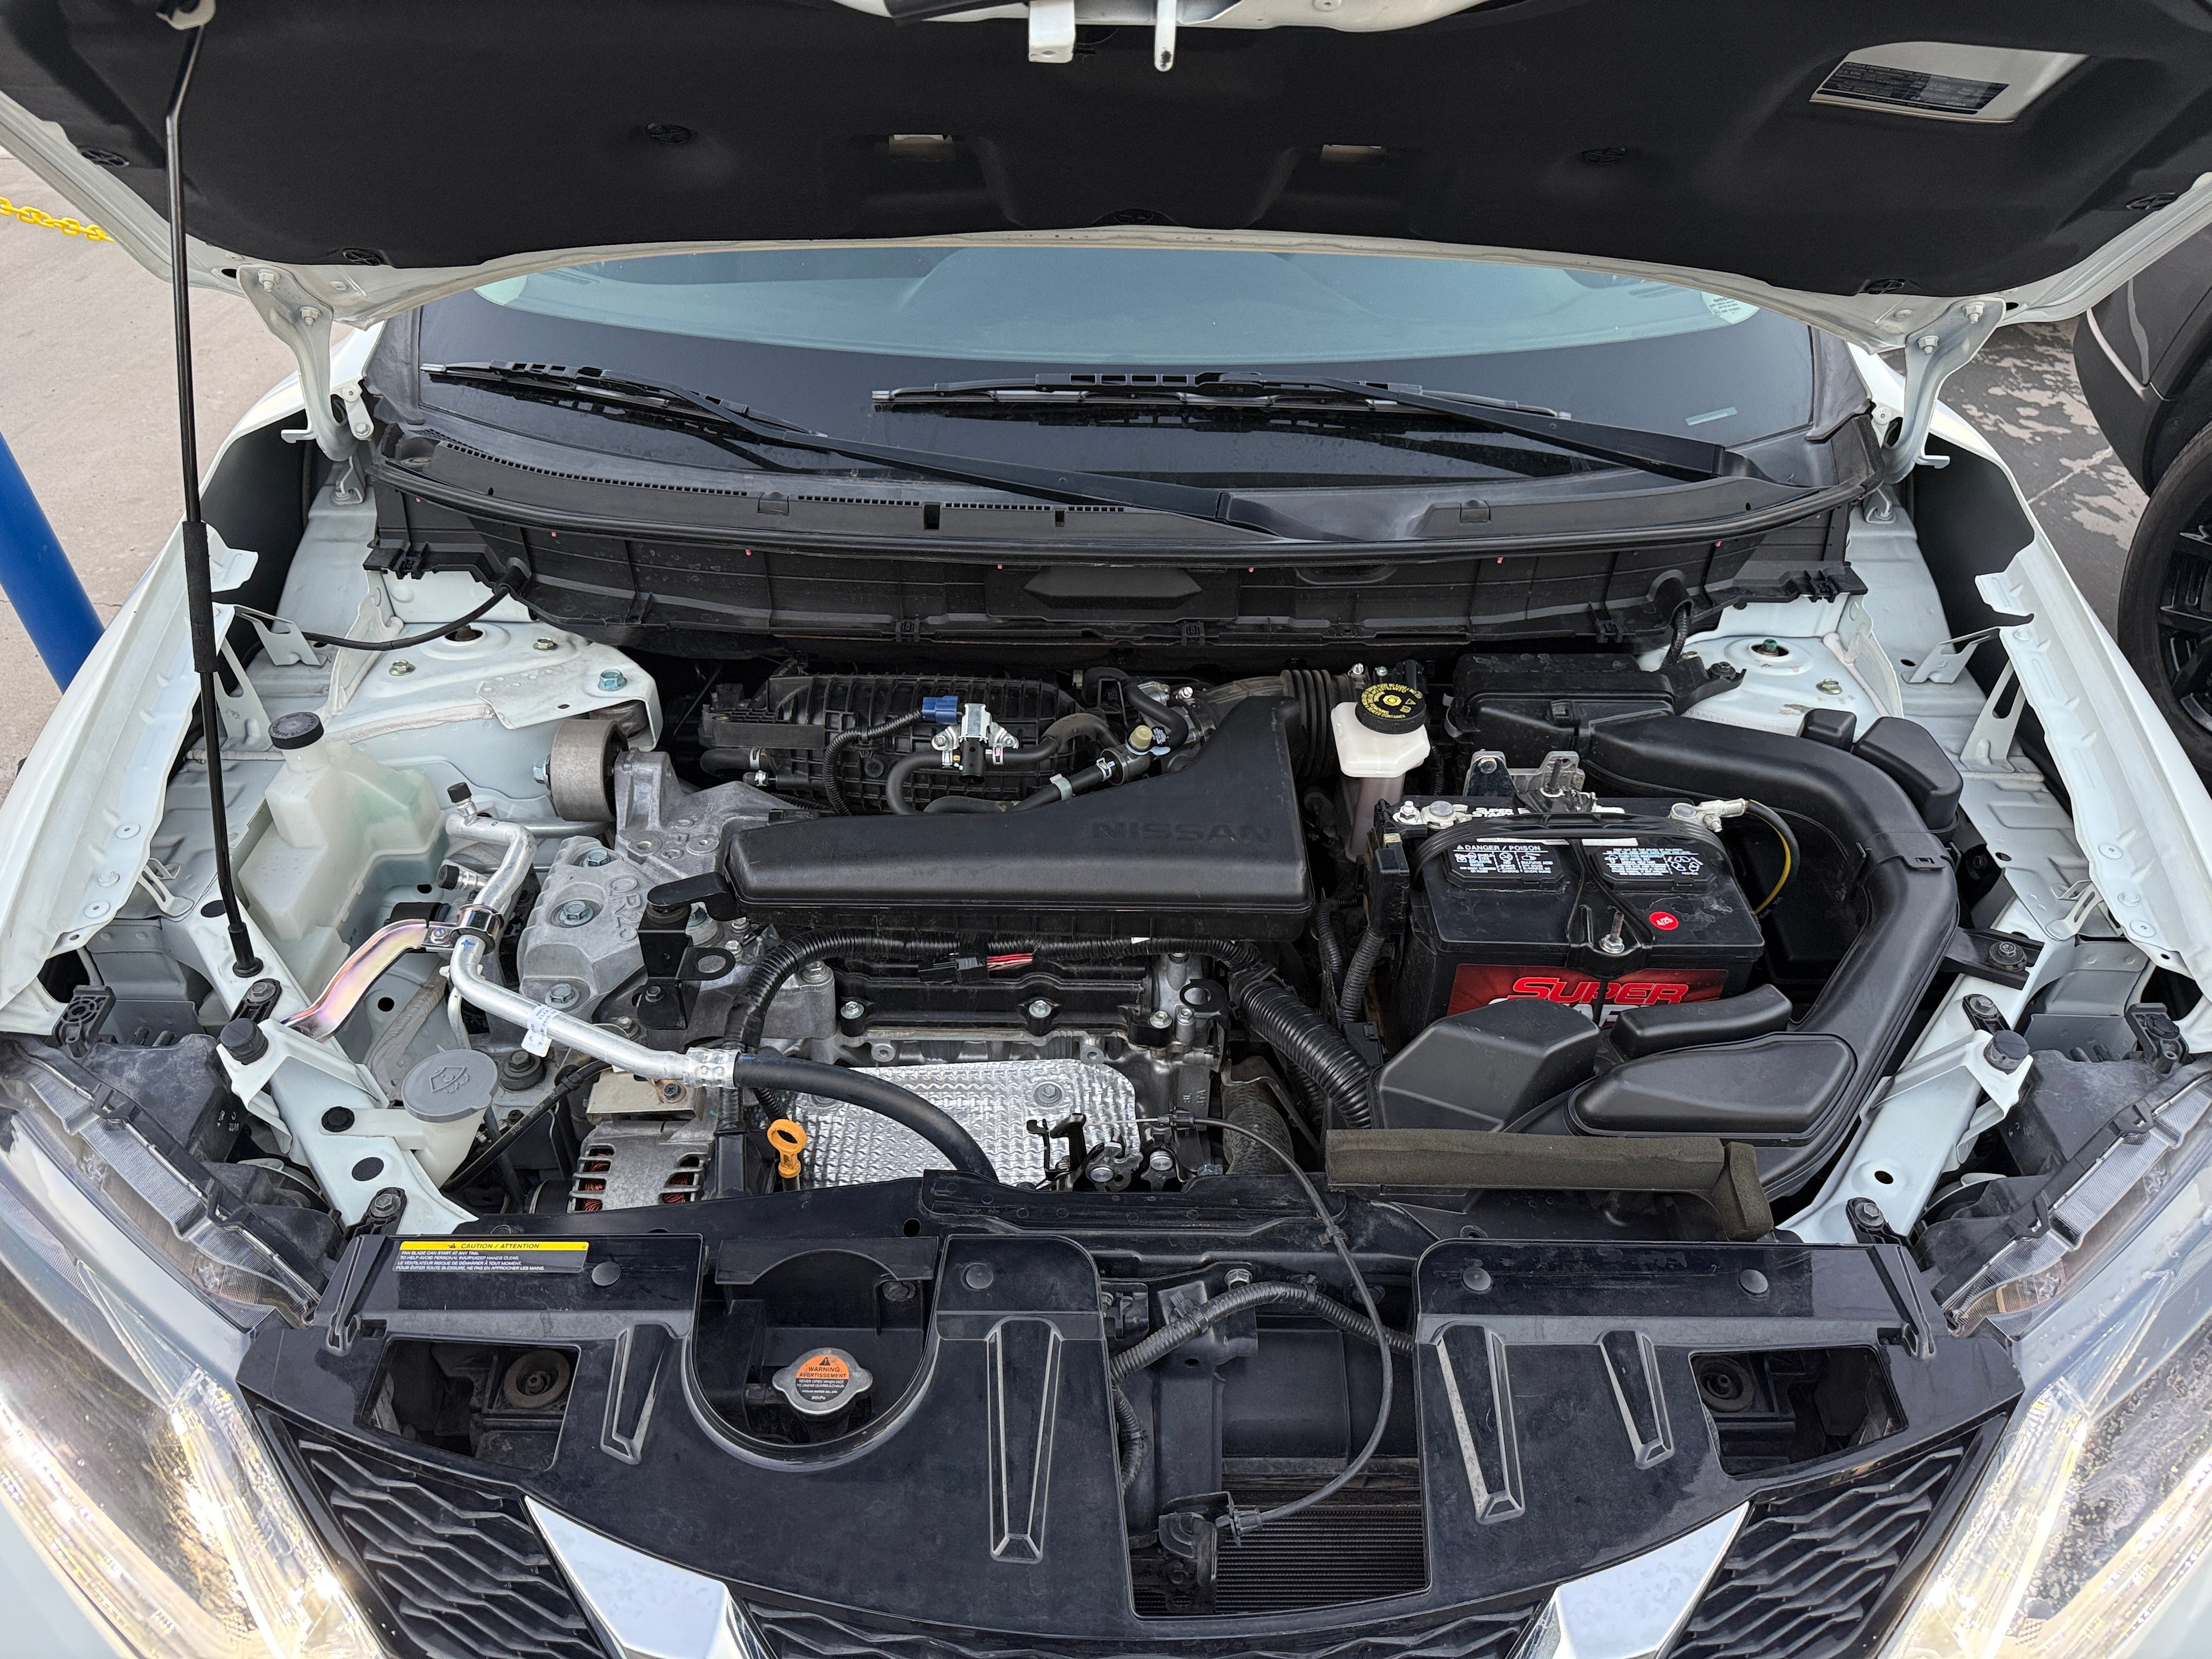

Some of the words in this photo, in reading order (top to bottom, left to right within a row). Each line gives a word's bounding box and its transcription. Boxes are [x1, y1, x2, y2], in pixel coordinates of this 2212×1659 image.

[1092, 822, 1272, 843] NISSAN
[1656, 916, 1673, 926] 4/25
[1507, 977, 1689, 1005] SUPER
[510, 1122, 523, 1136] 2015
